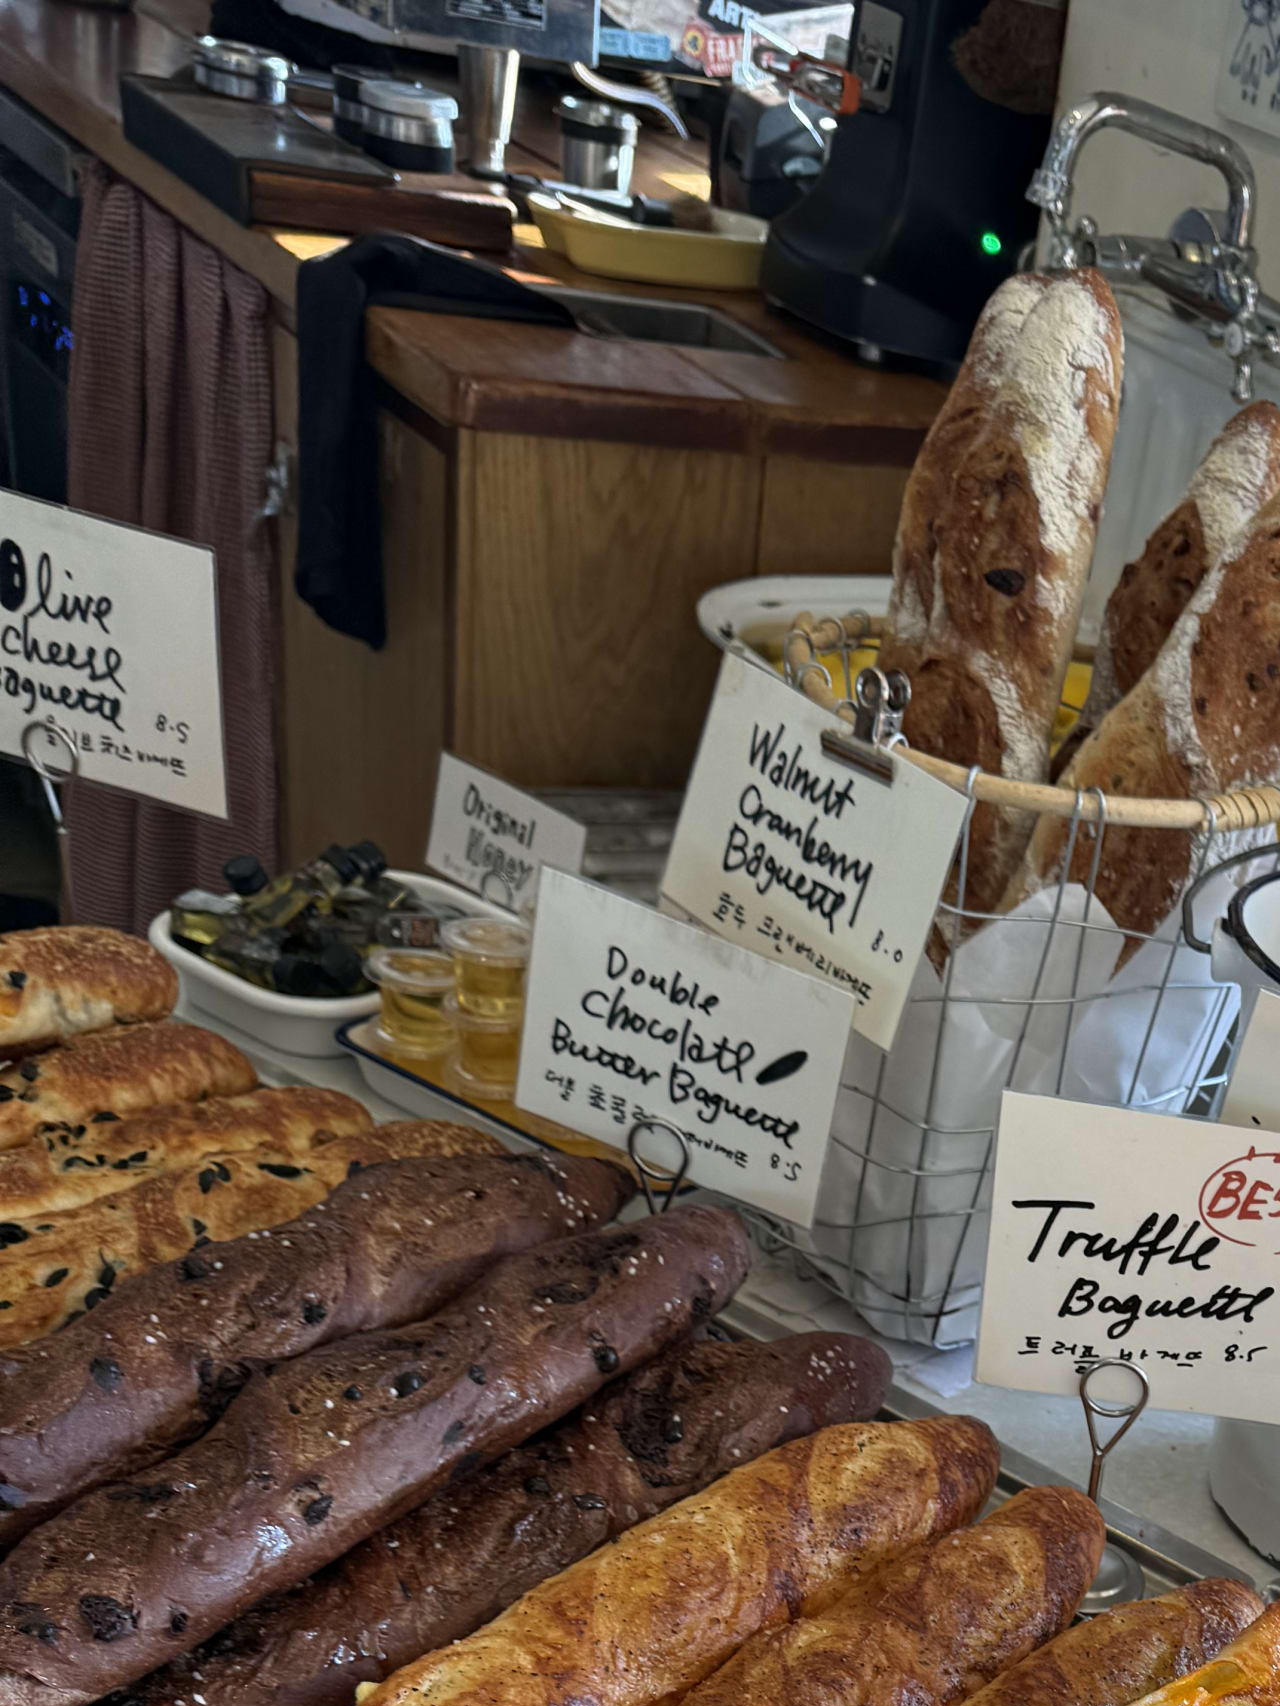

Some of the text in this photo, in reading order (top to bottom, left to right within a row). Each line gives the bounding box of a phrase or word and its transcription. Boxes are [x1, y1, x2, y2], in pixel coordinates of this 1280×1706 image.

[0, 538, 113, 634] Olive
[0, 666, 125, 733] aguette
[607, 945, 721, 1018] Double
[581, 987, 757, 1084] Chocolate
[551, 1018, 801, 1150] Butter Baguette
[1011, 1200, 1222, 1276] Truffle
[1058, 1277, 1276, 1340] Baguette
[1223, 1343, 1269, 1363] 8.5
